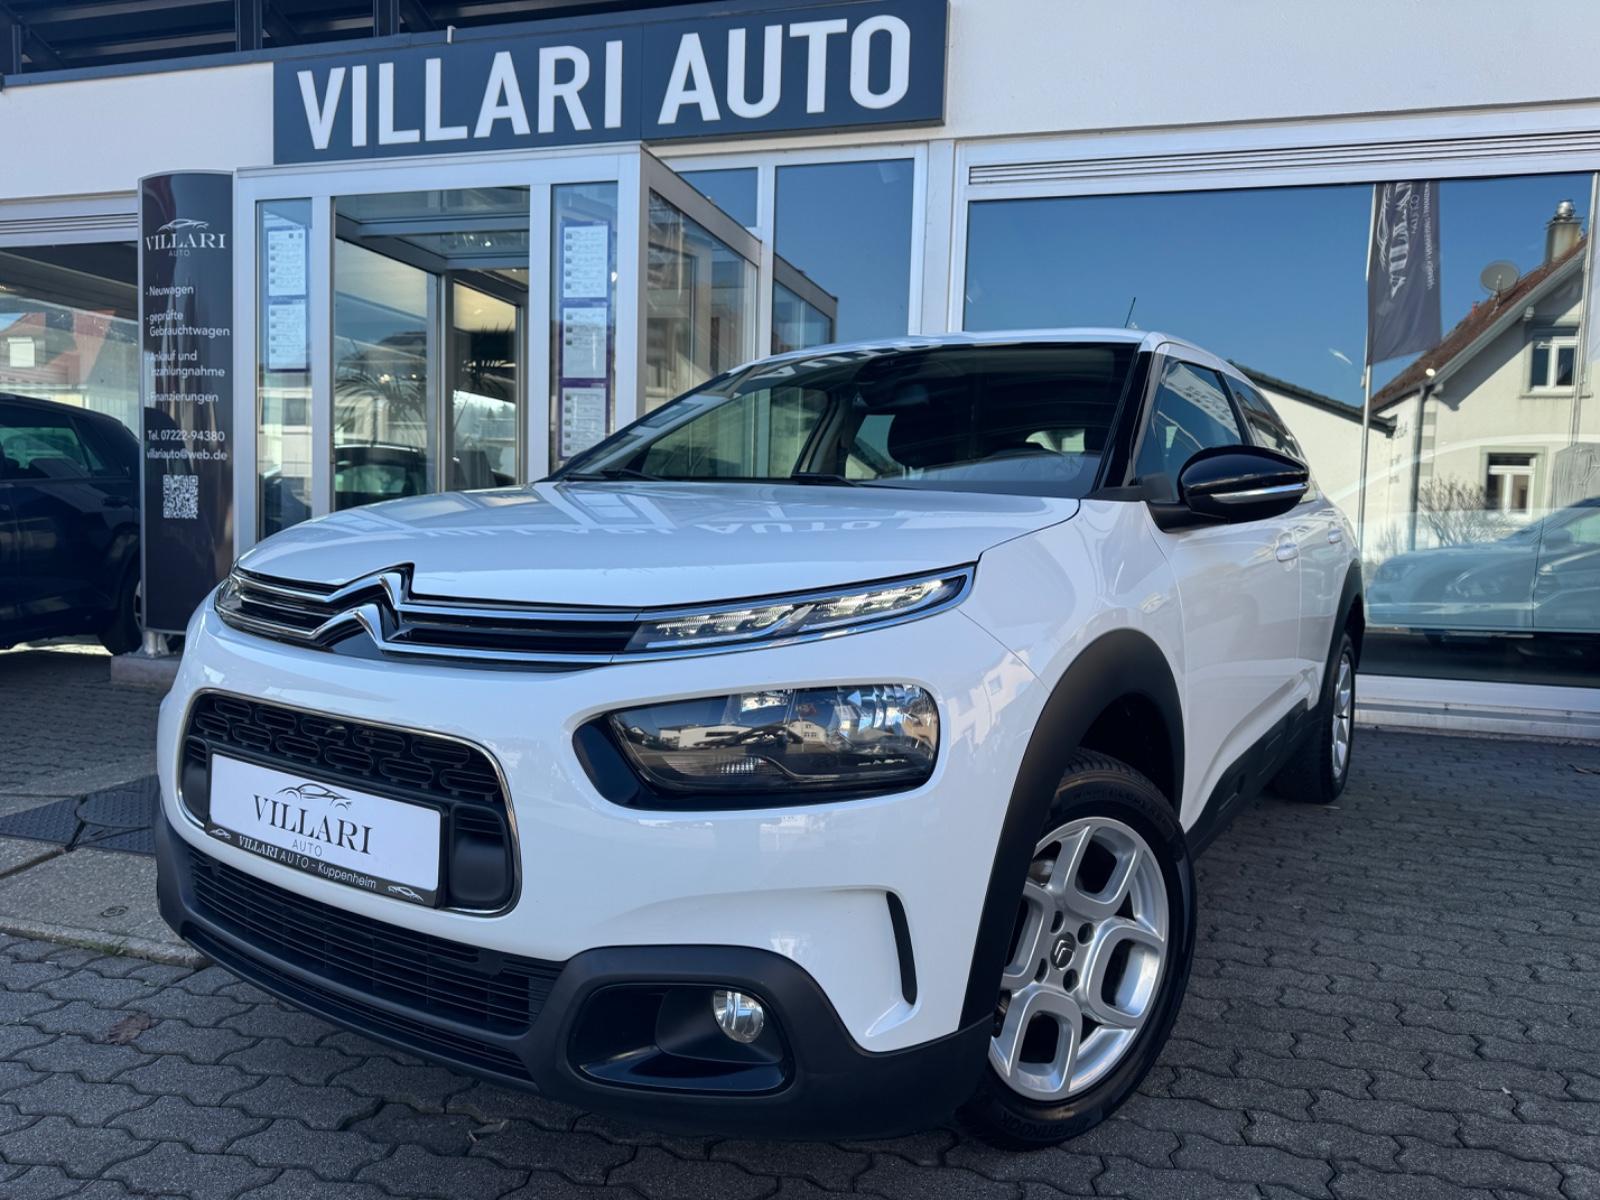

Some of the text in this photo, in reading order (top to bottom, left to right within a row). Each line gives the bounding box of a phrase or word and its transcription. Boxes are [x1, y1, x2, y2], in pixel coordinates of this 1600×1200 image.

[297, 14, 912, 150] VILLARI AUTO
[145, 233, 227, 251] VILLARI
[149, 285, 194, 298] Neuwagen
[149, 309, 184, 325] geprüfte
[149, 324, 231, 339] Gebrauchtwagen
[178, 349, 198, 361] und
[151, 391, 219, 405] Finanzierungen
[160, 430, 226, 442] 07222-94380
[146, 447, 229, 461] villariauto@web.de
[253, 794, 374, 856] VILLARI
[291, 838, 323, 858] AUTO
[237, 835, 279, 860] VILLARI
[279, 850, 309, 870] AUTO
[317, 861, 377, 890] Kuppenheim
